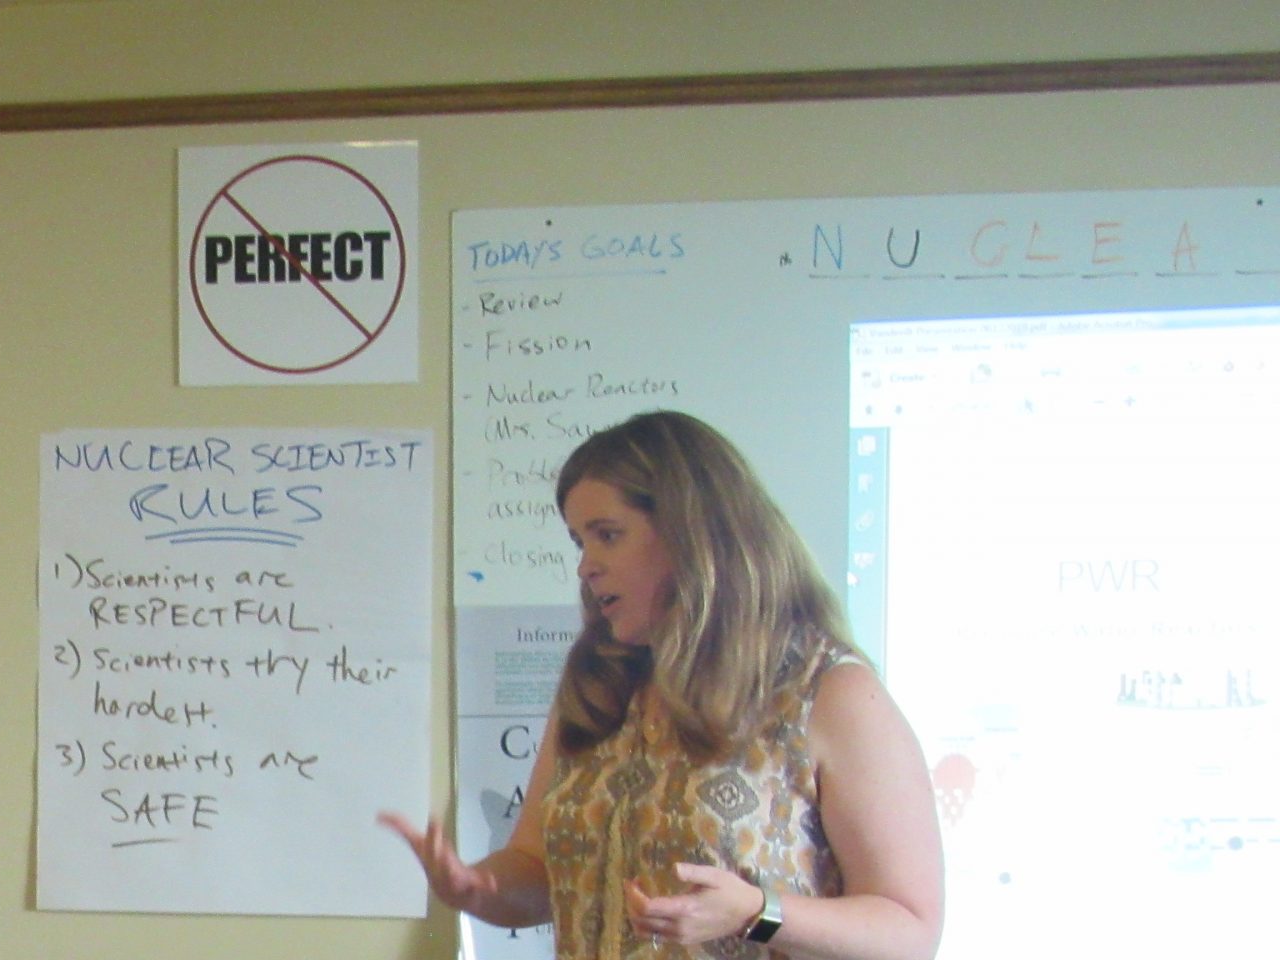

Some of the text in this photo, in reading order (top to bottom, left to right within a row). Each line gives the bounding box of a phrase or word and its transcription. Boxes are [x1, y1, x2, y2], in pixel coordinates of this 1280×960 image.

[205, 231, 391, 284] PERFECT
[581, 232, 685, 260] GOALS
[479, 291, 563, 317] Review
[485, 329, 592, 361] Fission
[487, 373, 679, 407] Nuclear Reactors
[55, 437, 421, 475] NUCLEAR SCIENTIST
[129, 483, 323, 524] RULES
[488, 500, 556, 527] assign
[484, 541, 568, 584] Closing
[1057, 559, 1161, 593] PWR
[236, 571, 295, 589] are
[517, 625, 574, 642] Inform
[94, 644, 231, 679] Scientists
[245, 647, 309, 694] try
[326, 645, 398, 685] their
[102, 741, 235, 777] Scientists
[259, 753, 318, 781] are
[101, 788, 219, 830] SAFE
